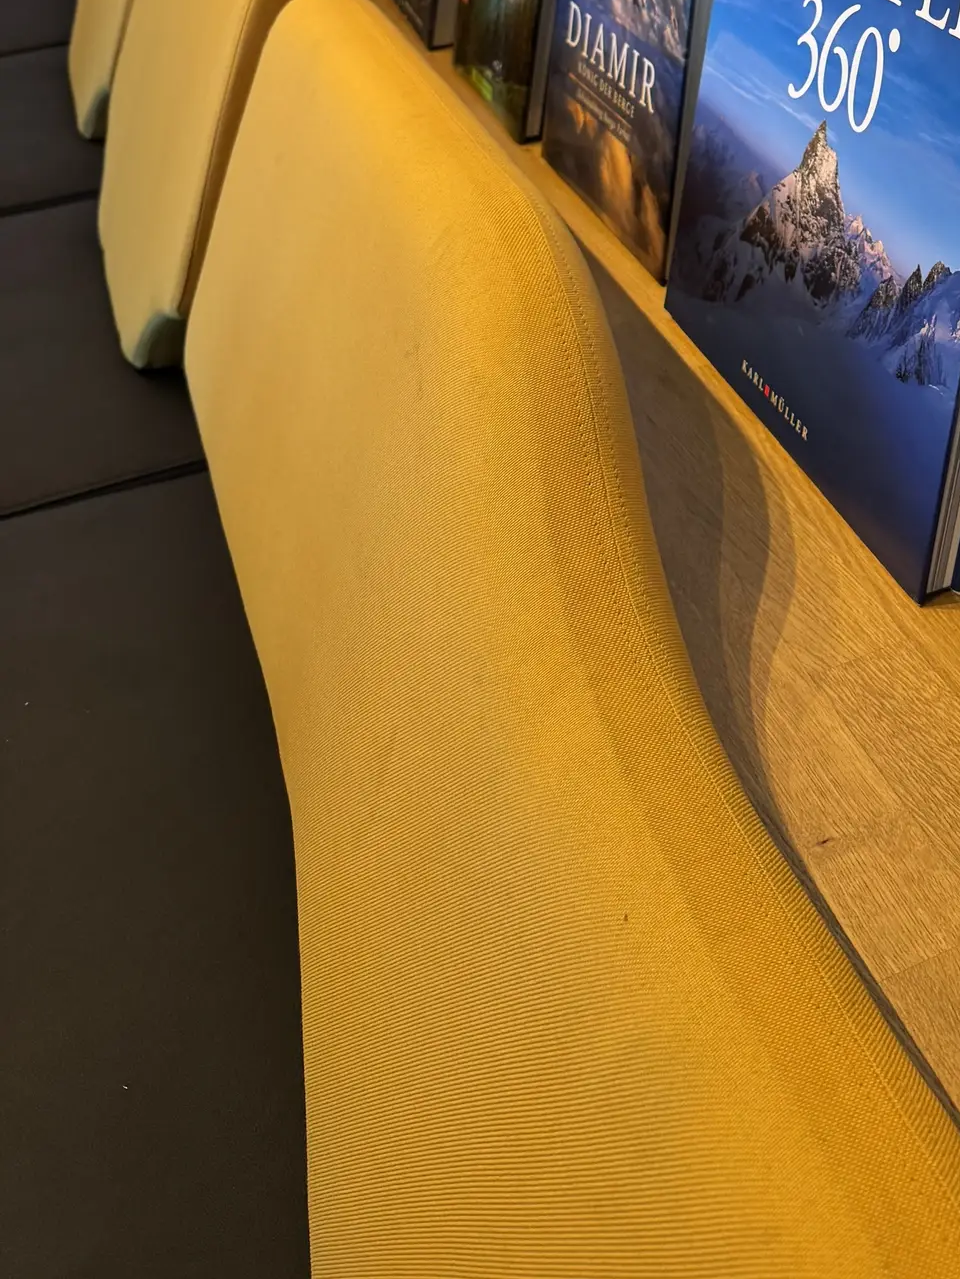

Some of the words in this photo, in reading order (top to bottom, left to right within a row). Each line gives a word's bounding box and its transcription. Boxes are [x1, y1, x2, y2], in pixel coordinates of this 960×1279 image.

[565, 0, 656, 114] DIAMIR
[741, 359, 764, 391] KARL
[770, 391, 809, 442] MÜLLER
